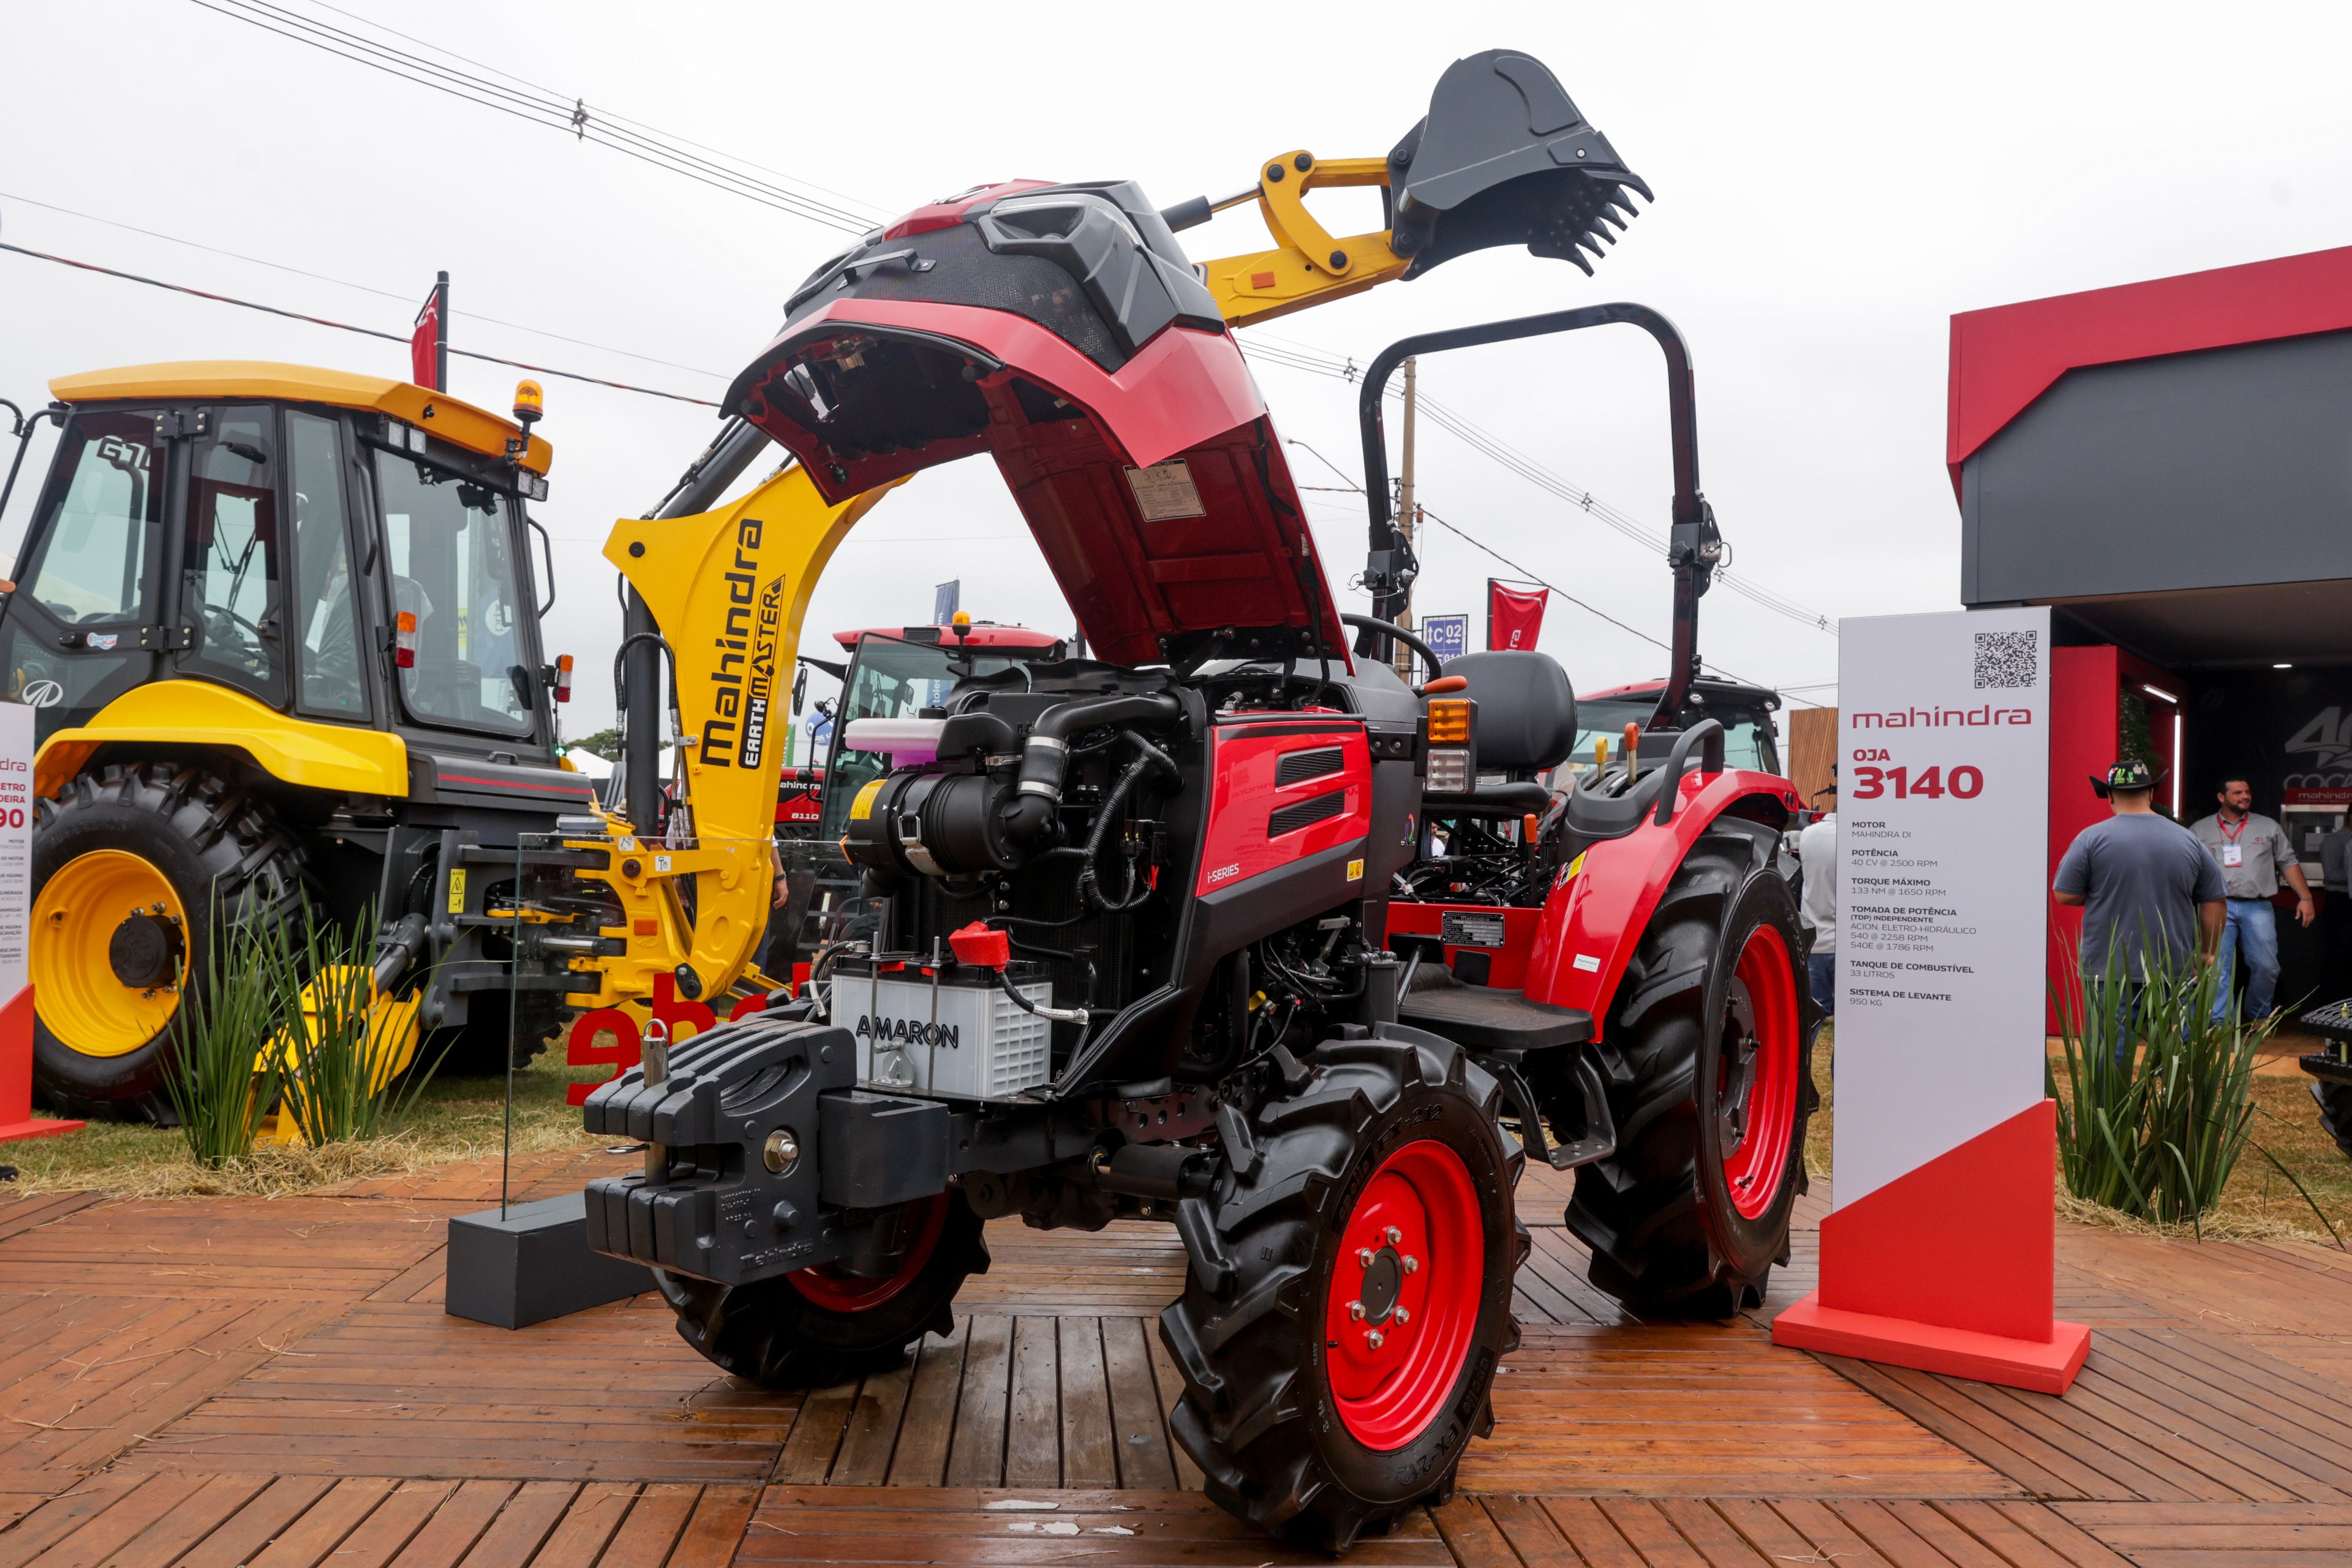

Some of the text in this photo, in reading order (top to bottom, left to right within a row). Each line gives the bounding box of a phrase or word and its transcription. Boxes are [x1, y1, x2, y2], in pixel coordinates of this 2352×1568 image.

[1434, 625, 1461, 643] C 02
[1852, 704, 2031, 728] mahindra
[1853, 749, 1891, 761] OJA
[1853, 766, 1983, 799] 3140
[1207, 863, 1239, 884] i-SERIES
[1909, 907, 1956, 916] POTÊNCIA
[1882, 924, 1976, 934] ELETRO-HIDRÁULICO
[1850, 960, 1888, 969] TANQUE
[1906, 963, 1974, 973] COMBUSTÍVEL
[1850, 989, 1890, 997] SISTEMA
[1909, 992, 1951, 1001] LEVANTE
[856, 1015, 959, 1049] AMARON
